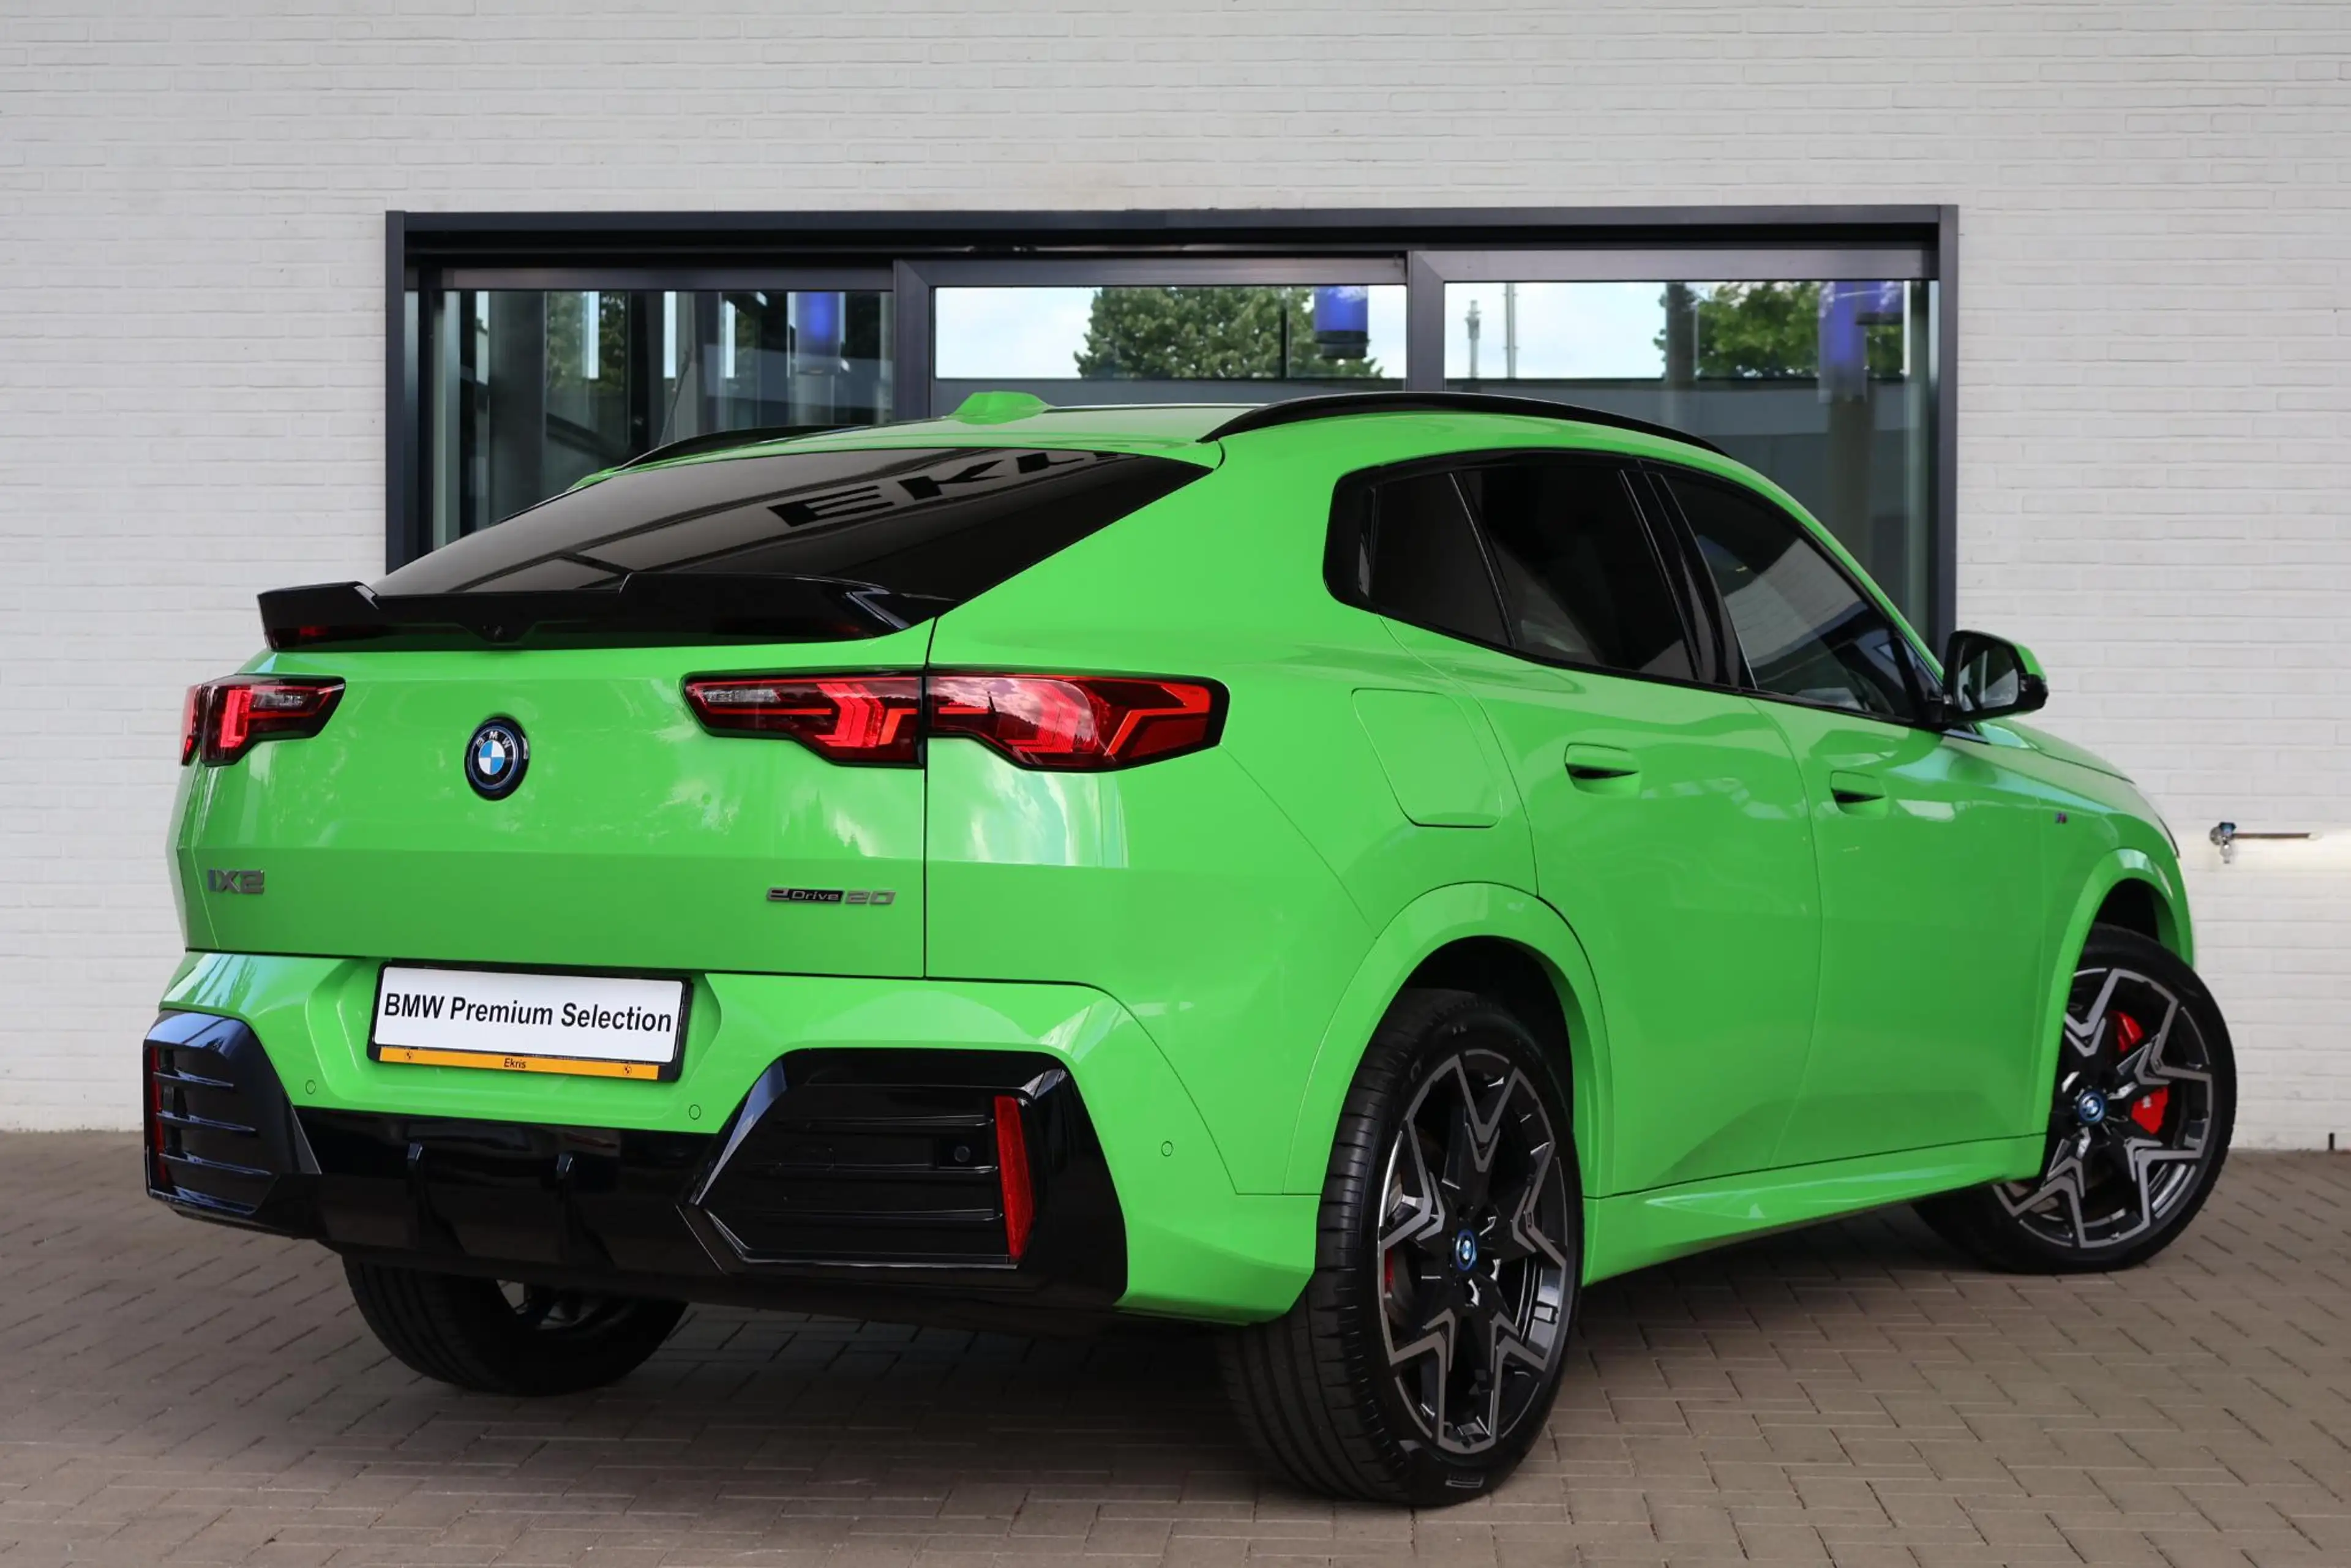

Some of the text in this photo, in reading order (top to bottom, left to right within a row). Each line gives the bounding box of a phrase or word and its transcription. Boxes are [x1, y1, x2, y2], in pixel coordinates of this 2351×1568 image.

[846, 890, 896, 905] 20
[384, 993, 672, 1032] BMW Premium Selection
[503, 1057, 527, 1069] Ekris
